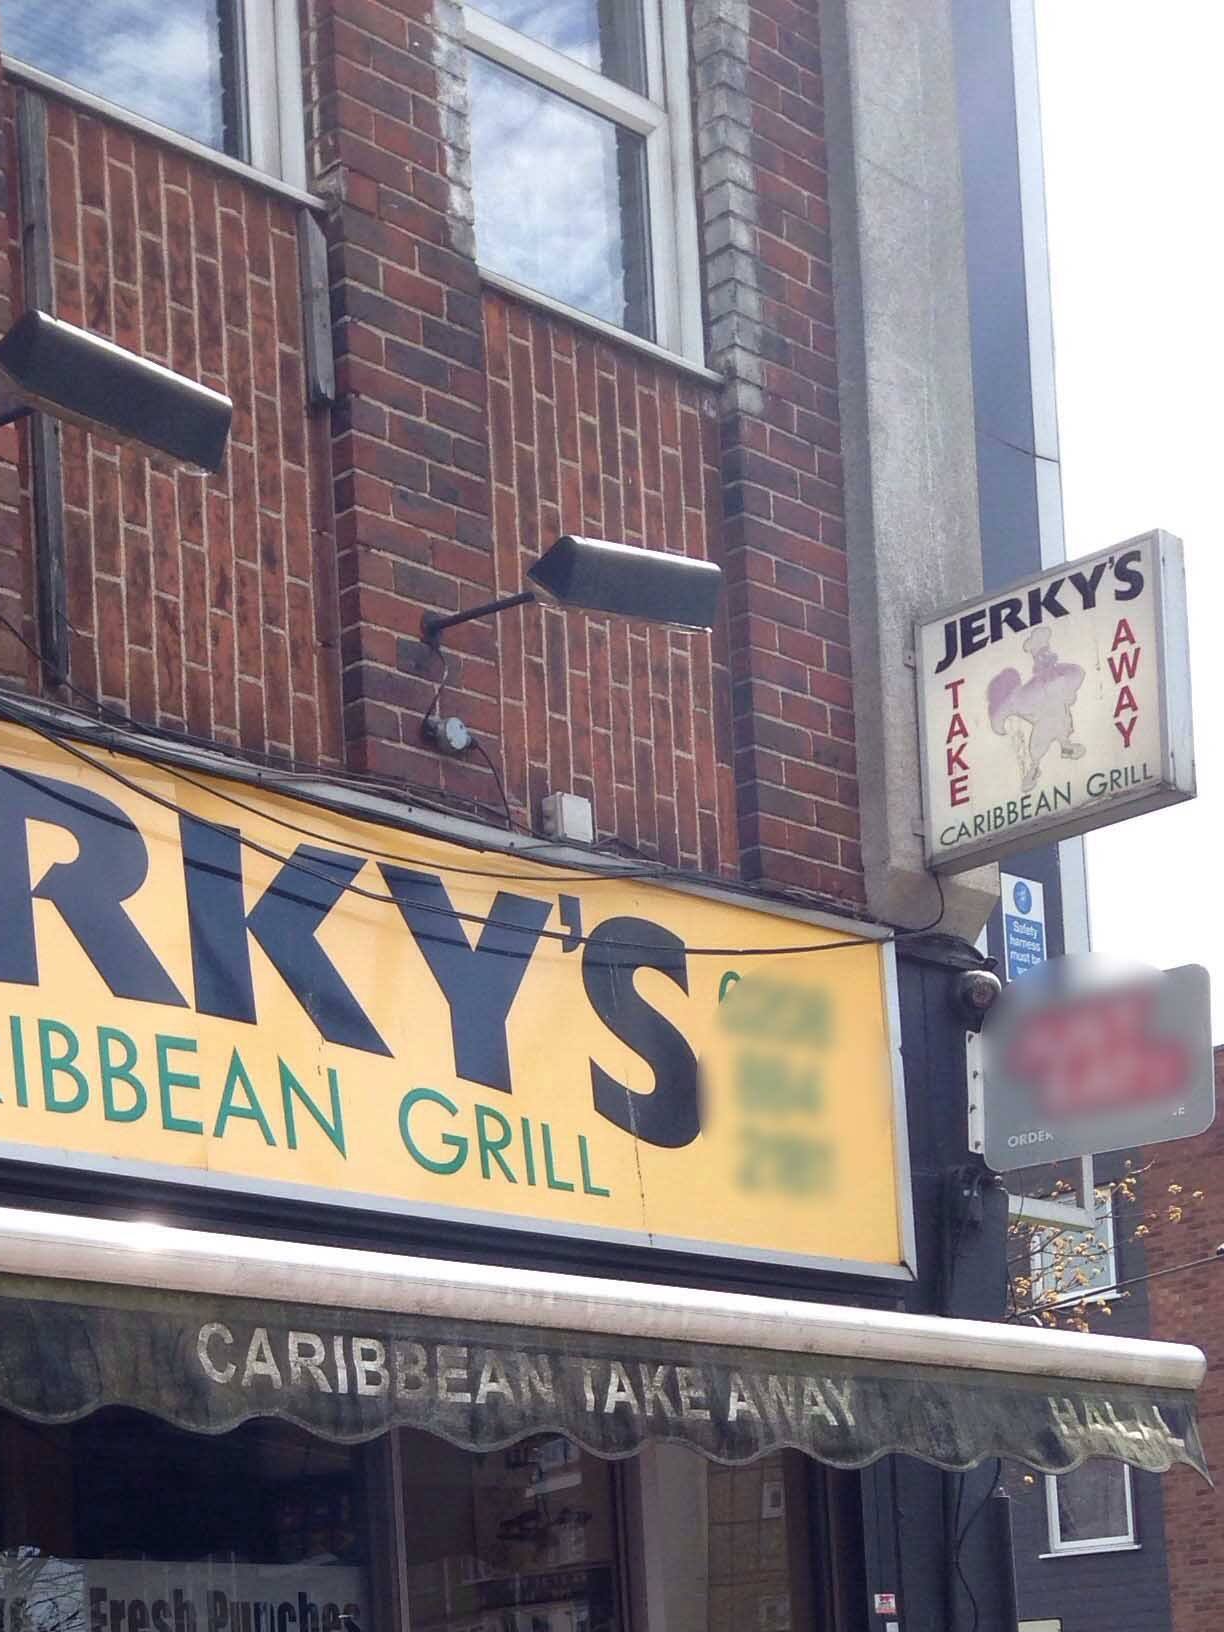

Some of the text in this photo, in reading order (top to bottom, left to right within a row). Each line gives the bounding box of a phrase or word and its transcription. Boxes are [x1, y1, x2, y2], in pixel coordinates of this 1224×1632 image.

[935, 550, 1145, 674] JERKY'S
[1107, 618, 1141, 748] AWAY
[944, 679, 970, 807] TAKE
[940, 762, 1153, 846] CARIBBEAN GRILL
[1009, 933, 1041, 952] harness
[1012, 920, 1038, 940] Safety
[398, 1087, 610, 1198] GRILL
[196, 1321, 857, 1427] CARIBBEAN TAKE AWAY
